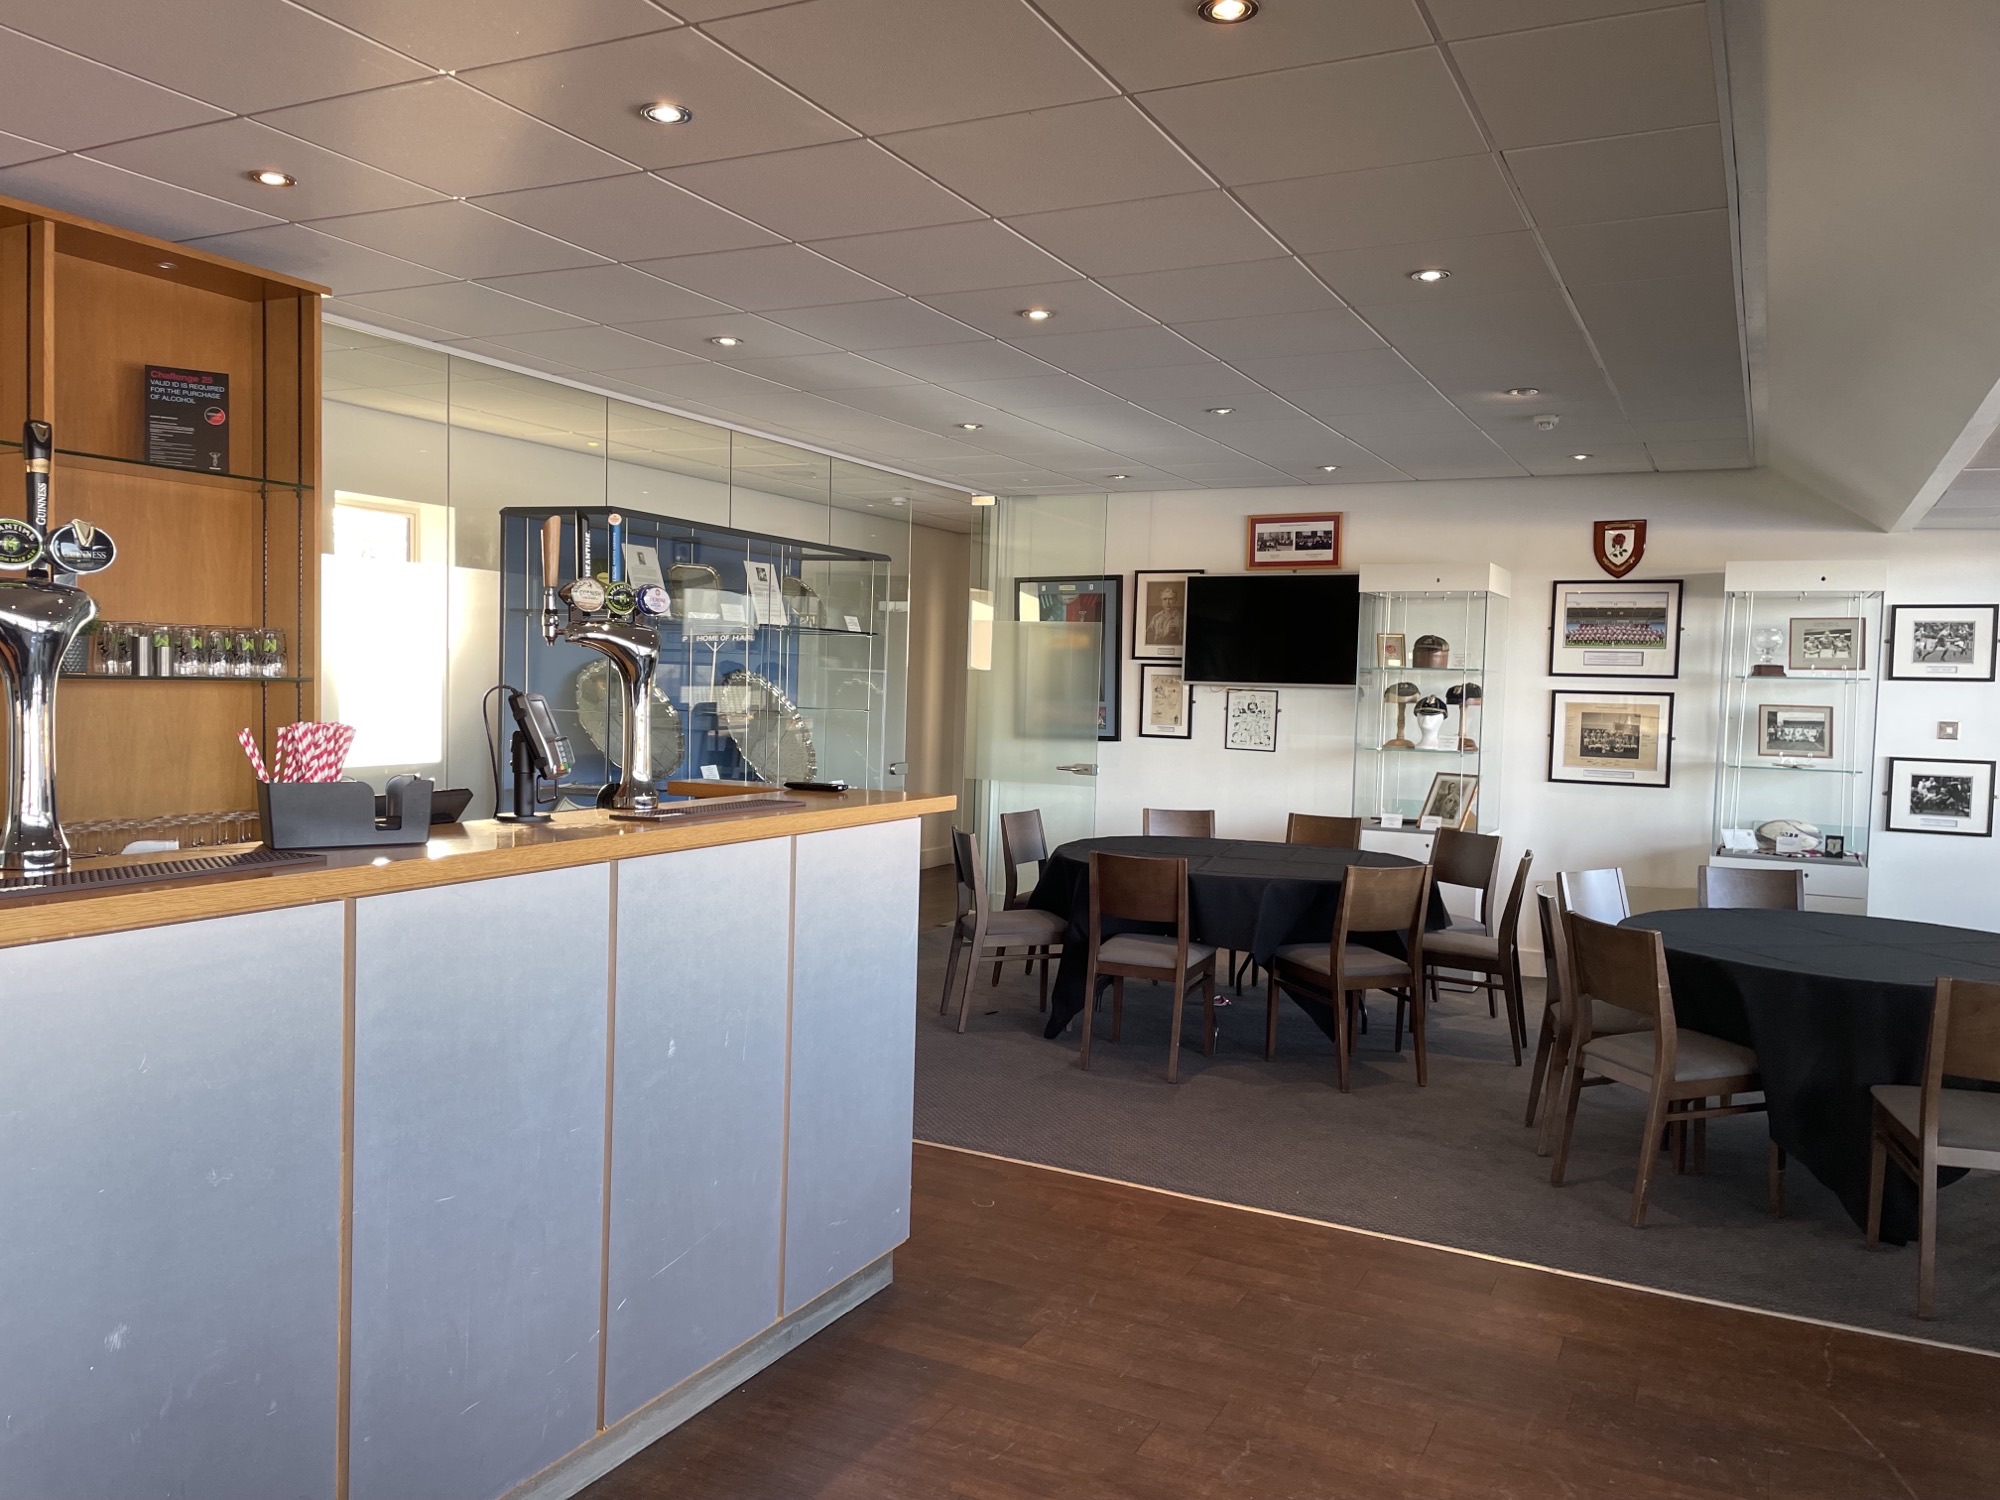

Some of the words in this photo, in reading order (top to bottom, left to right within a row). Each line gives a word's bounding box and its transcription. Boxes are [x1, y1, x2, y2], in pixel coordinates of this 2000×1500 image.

[150, 370, 199, 383] Challenge
[201, 376, 214, 384] 25
[150, 379, 171, 387] VALID
[189, 383, 225, 393] REQUIRED
[150, 386, 166, 394] FOR
[183, 390, 222, 399] PURCHASE
[161, 395, 196, 404] ALCOHOL
[35, 482, 47, 526] GUINNESS
